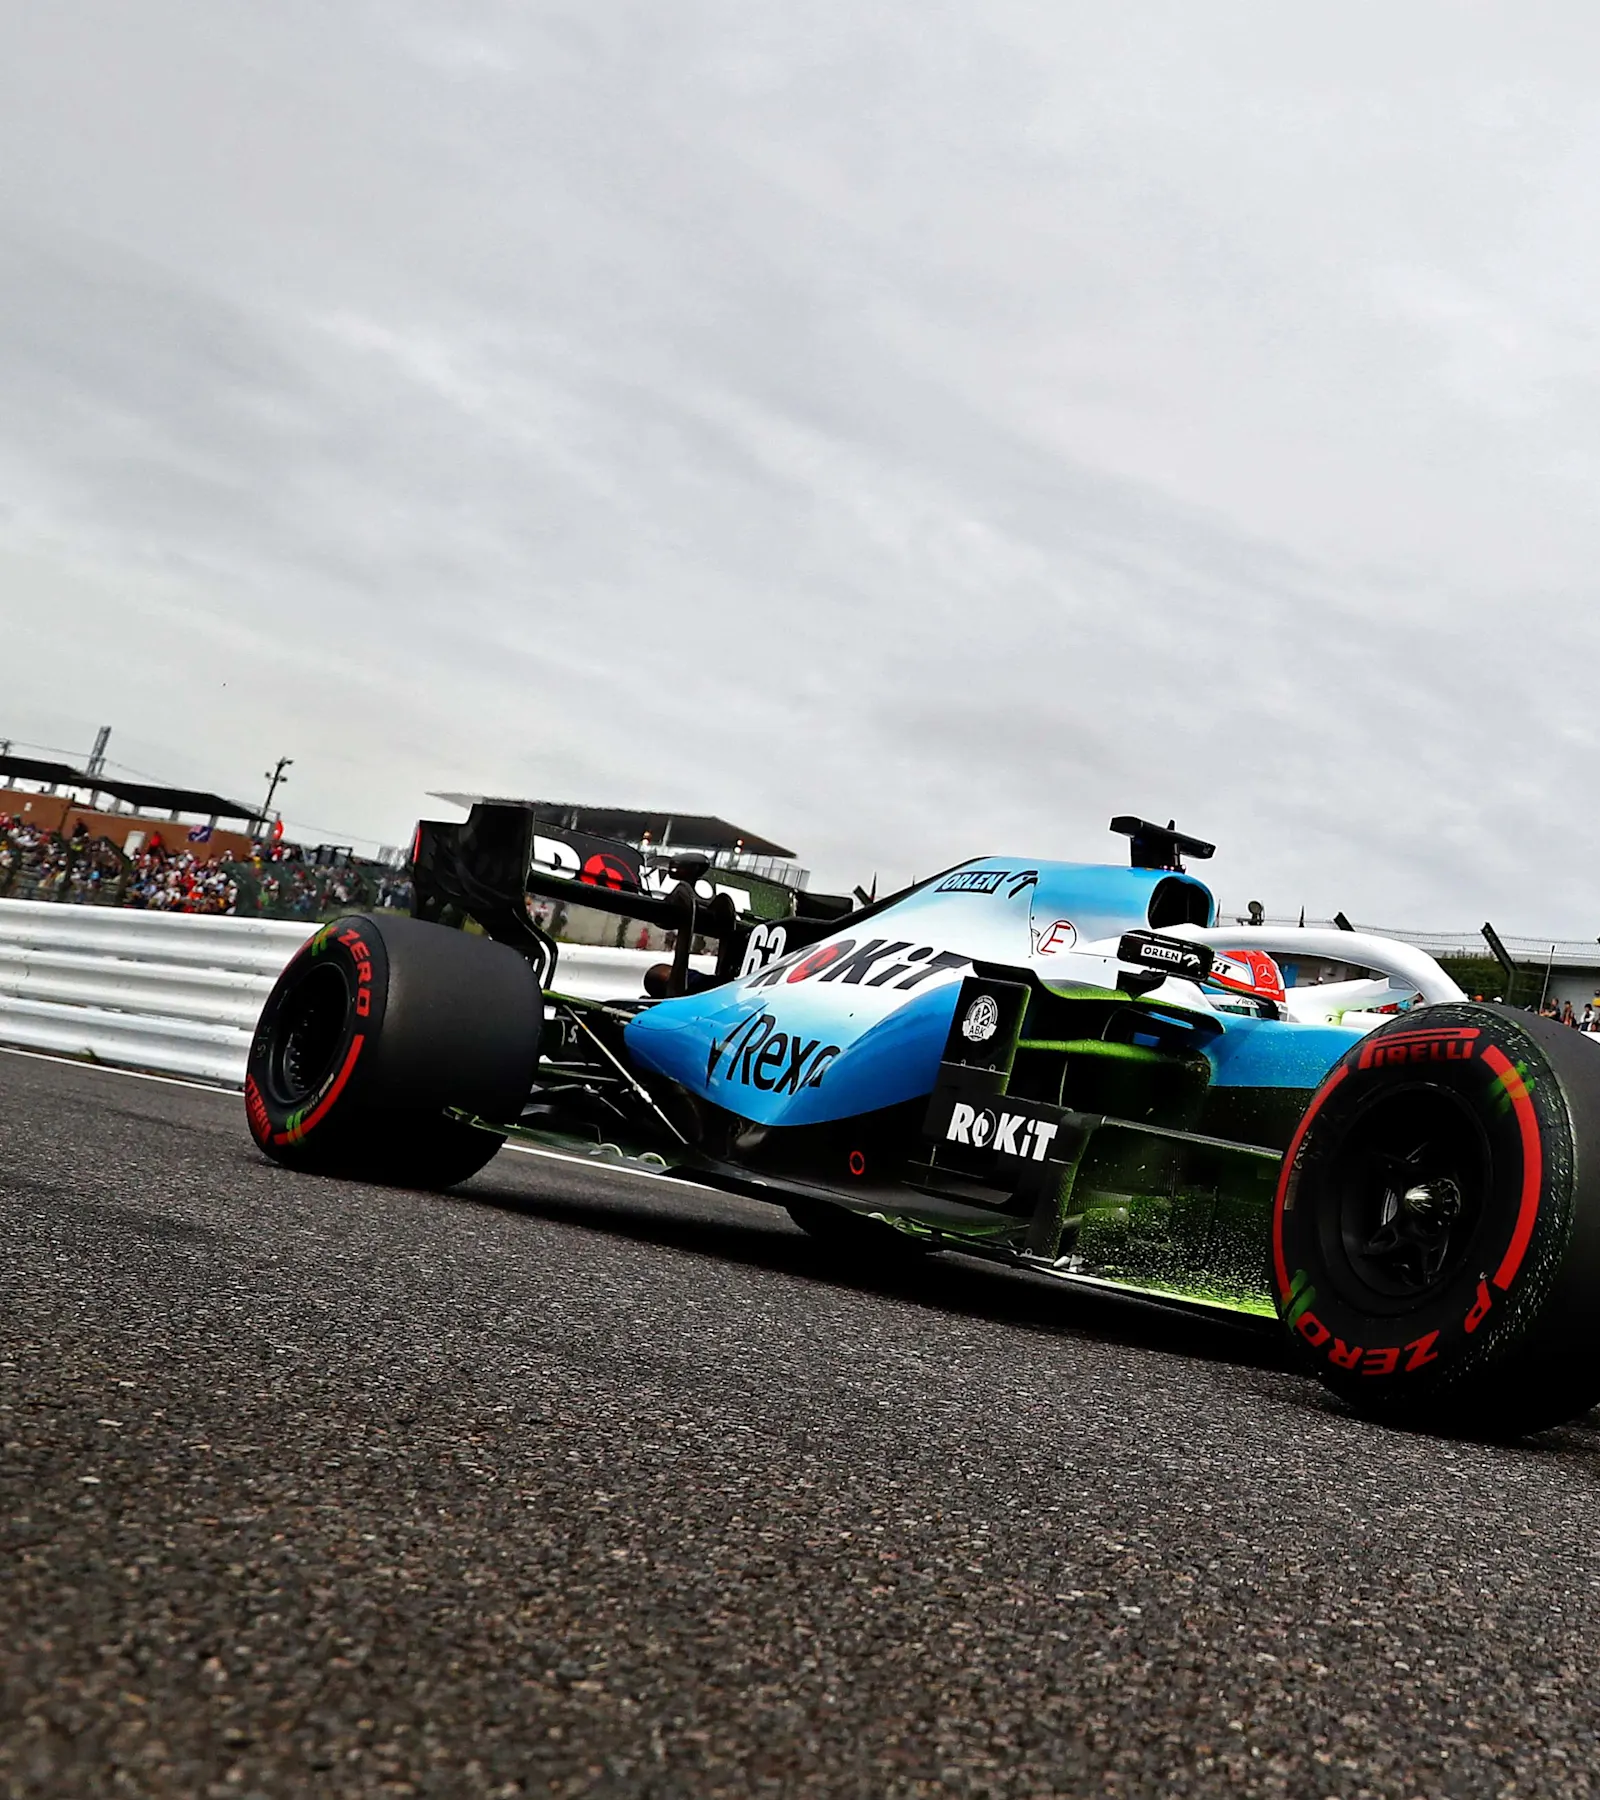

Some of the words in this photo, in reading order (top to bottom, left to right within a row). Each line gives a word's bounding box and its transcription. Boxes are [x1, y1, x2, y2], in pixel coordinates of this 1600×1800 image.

[941, 873, 1003, 891] ORLEN
[740, 924, 786, 979] 63
[1041, 924, 1071, 954] E
[1143, 946, 1180, 961] ORLEN
[338, 929, 373, 1017] ZERO
[969, 1026, 986, 1036] ABK
[1358, 1027, 1482, 1070] PIRELLI
[946, 1102, 1059, 1162] ROKiT
[1464, 1279, 1493, 1334] P
[1296, 1311, 1441, 1375] ZERO
